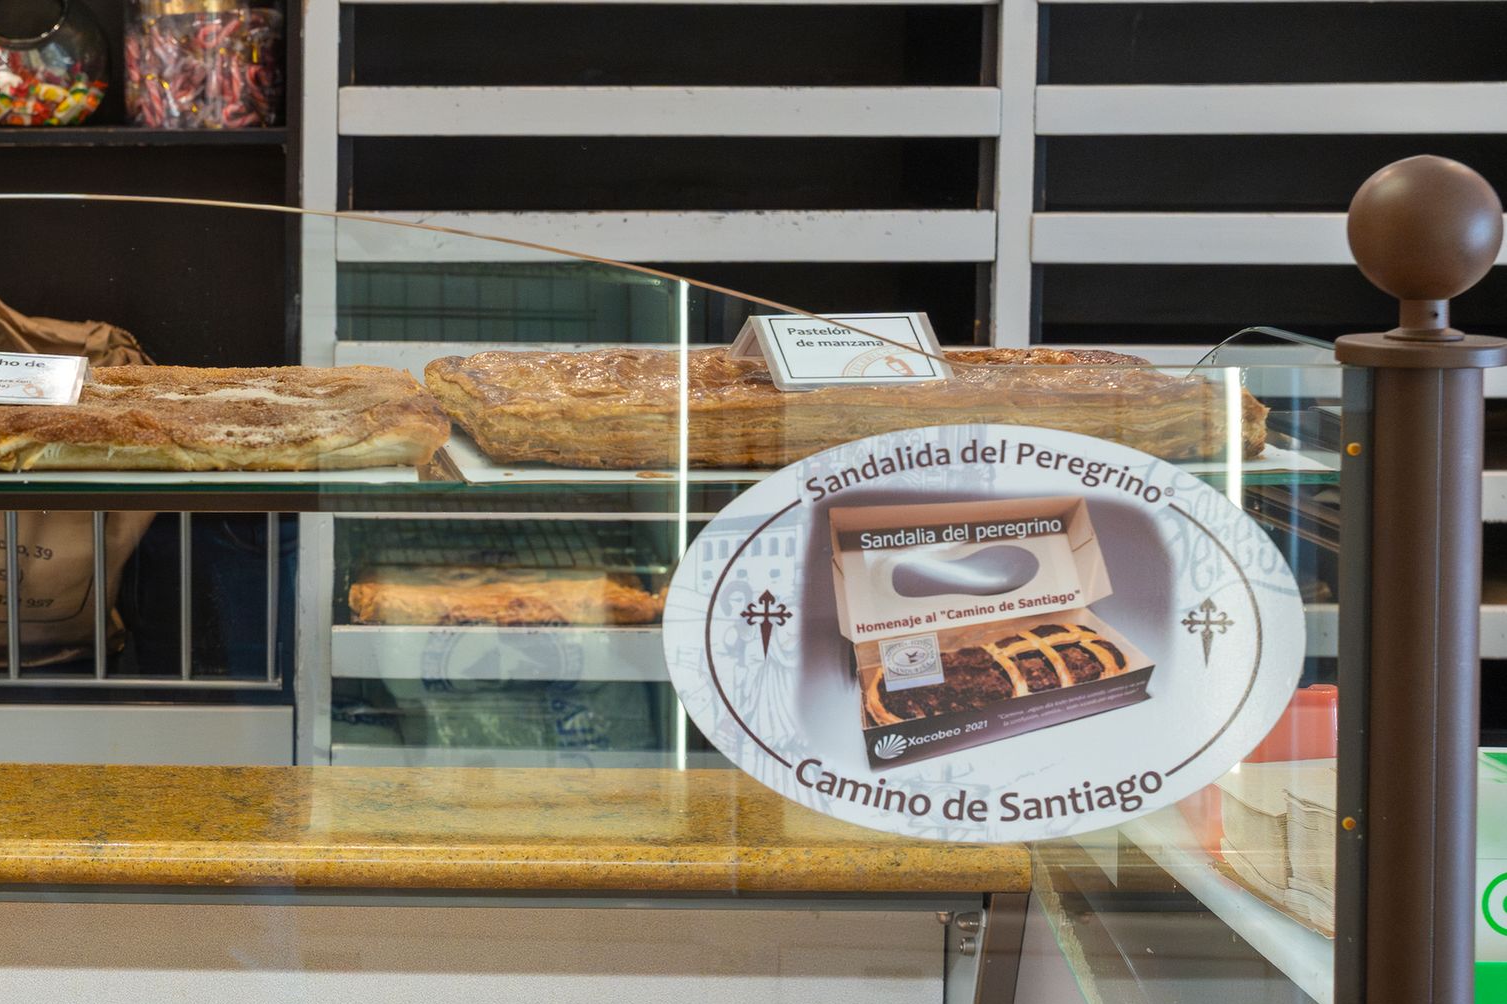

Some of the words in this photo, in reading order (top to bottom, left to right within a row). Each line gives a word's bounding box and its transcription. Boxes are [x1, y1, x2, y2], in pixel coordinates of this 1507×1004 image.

[787, 326, 851, 336] Pastelón
[796, 339, 814, 347] de
[818, 339, 884, 347] manzana
[24, 360, 46, 368] de
[806, 442, 952, 501] Sandalida
[960, 439, 1006, 464] del
[860, 528, 936, 549] Sandalia
[942, 524, 969, 541] del
[976, 518, 1062, 542] peregrino
[33, 545, 53, 560] 39
[856, 616, 922, 634] Homenaje
[925, 612, 937, 623] al
[940, 603, 995, 620] "Camino
[999, 601, 1014, 612] de
[1017, 589, 1081, 609] Santiago"
[906, 725, 961, 748] Xacobeo
[965, 719, 988, 733] 2021
[795, 758, 932, 816] Camino
[942, 790, 989, 822] de
[999, 770, 1164, 822] Santiago
